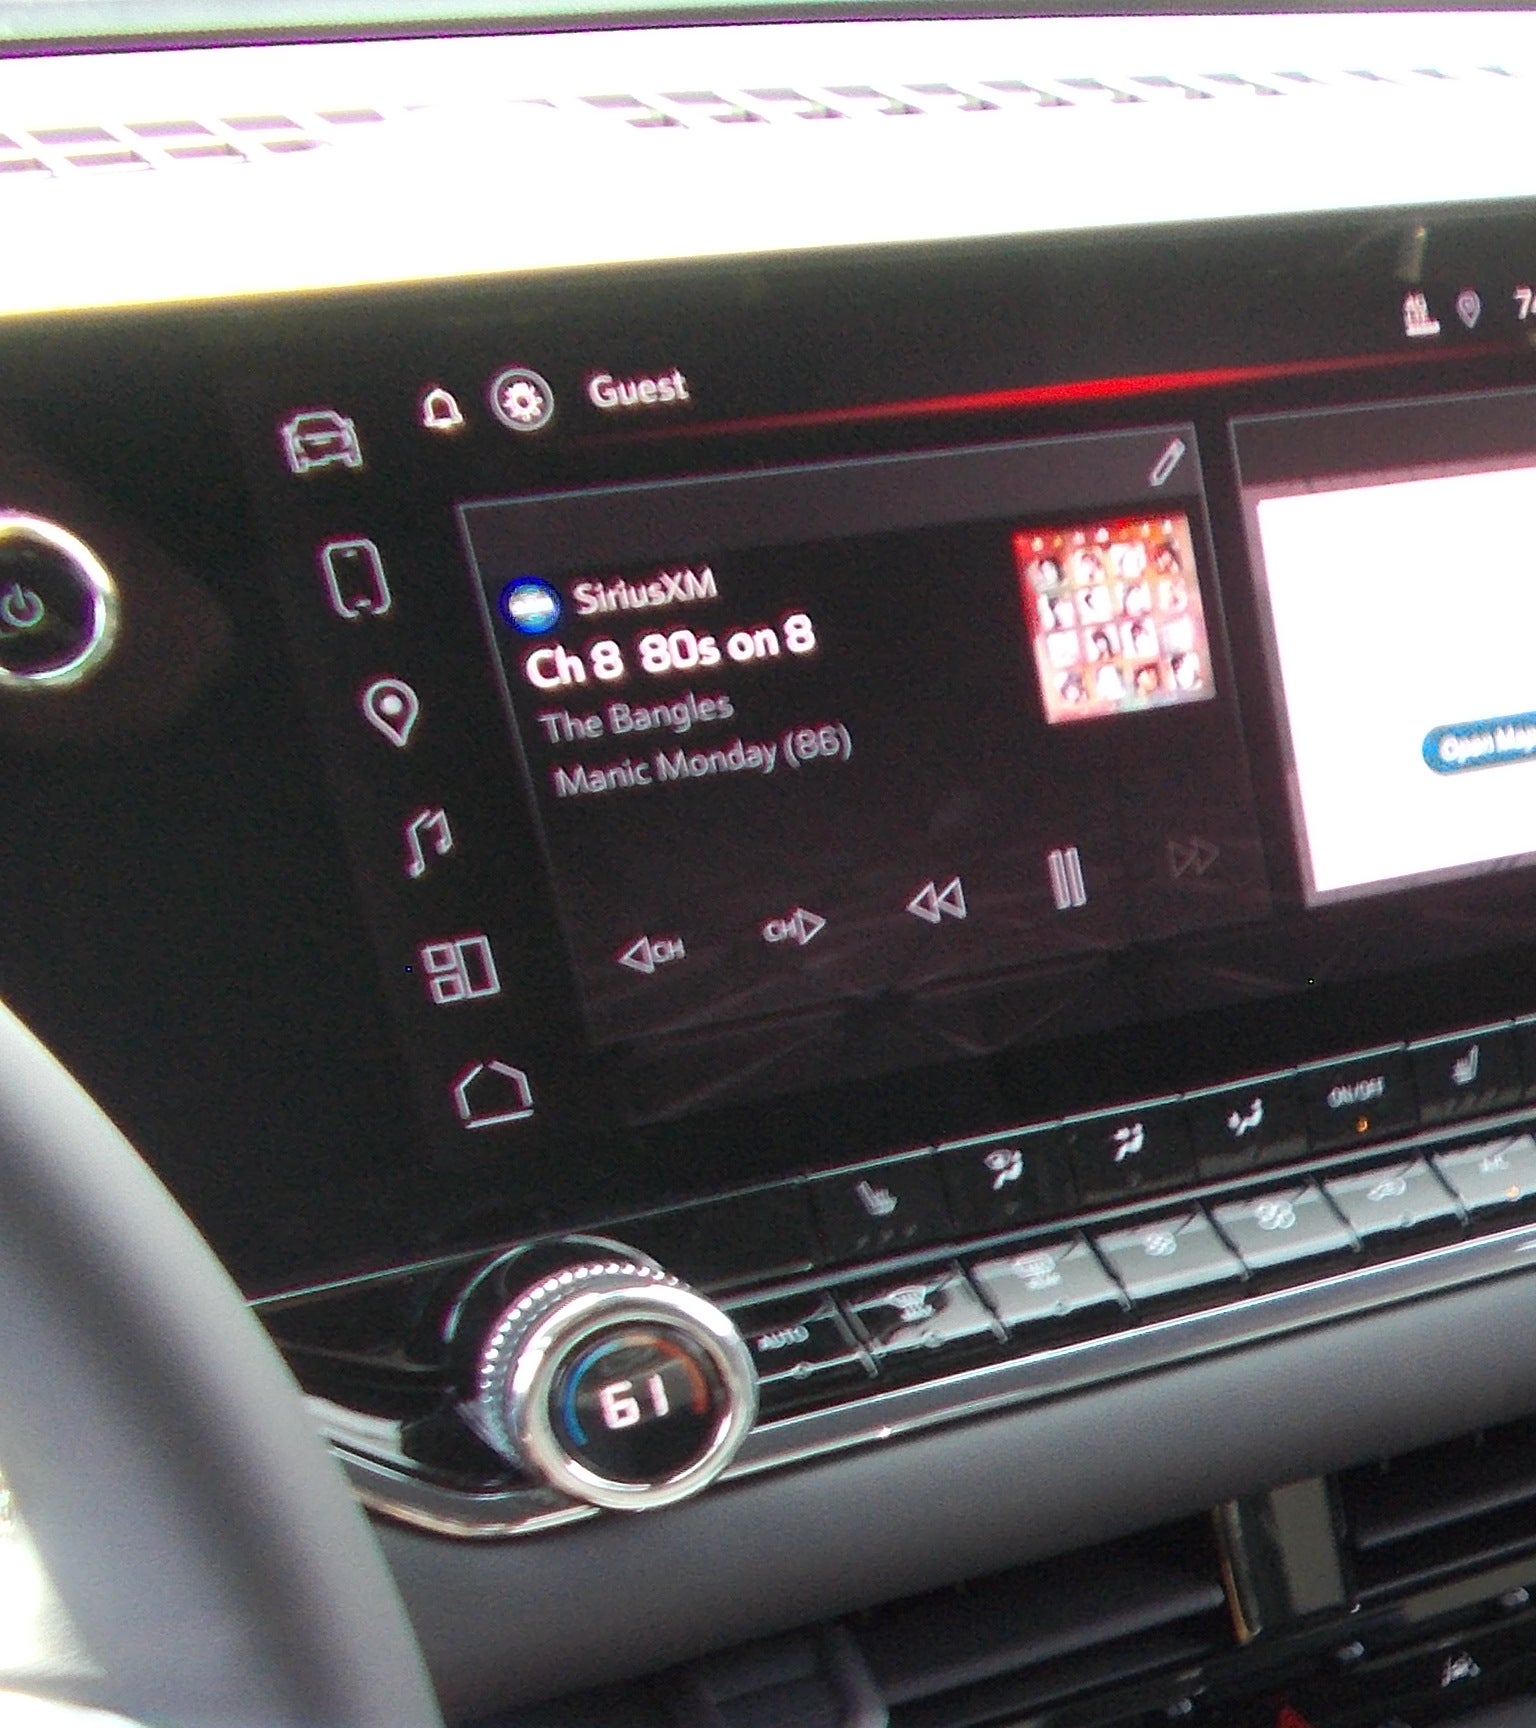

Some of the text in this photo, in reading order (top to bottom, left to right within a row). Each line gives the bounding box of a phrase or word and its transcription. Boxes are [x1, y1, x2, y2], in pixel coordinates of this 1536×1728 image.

[589, 369, 690, 410] Guest
[573, 565, 718, 616] SiriusXM
[526, 613, 816, 689] Ch 8 80s on 8
[538, 692, 735, 744] The Bangles
[555, 758, 653, 798] Manic
[656, 738, 778, 783] Monday
[652, 937, 686, 963] CH
[763, 917, 800, 943] CH
[1327, 1075, 1386, 1109] ON/OFF
[600, 1374, 669, 1431] 61
